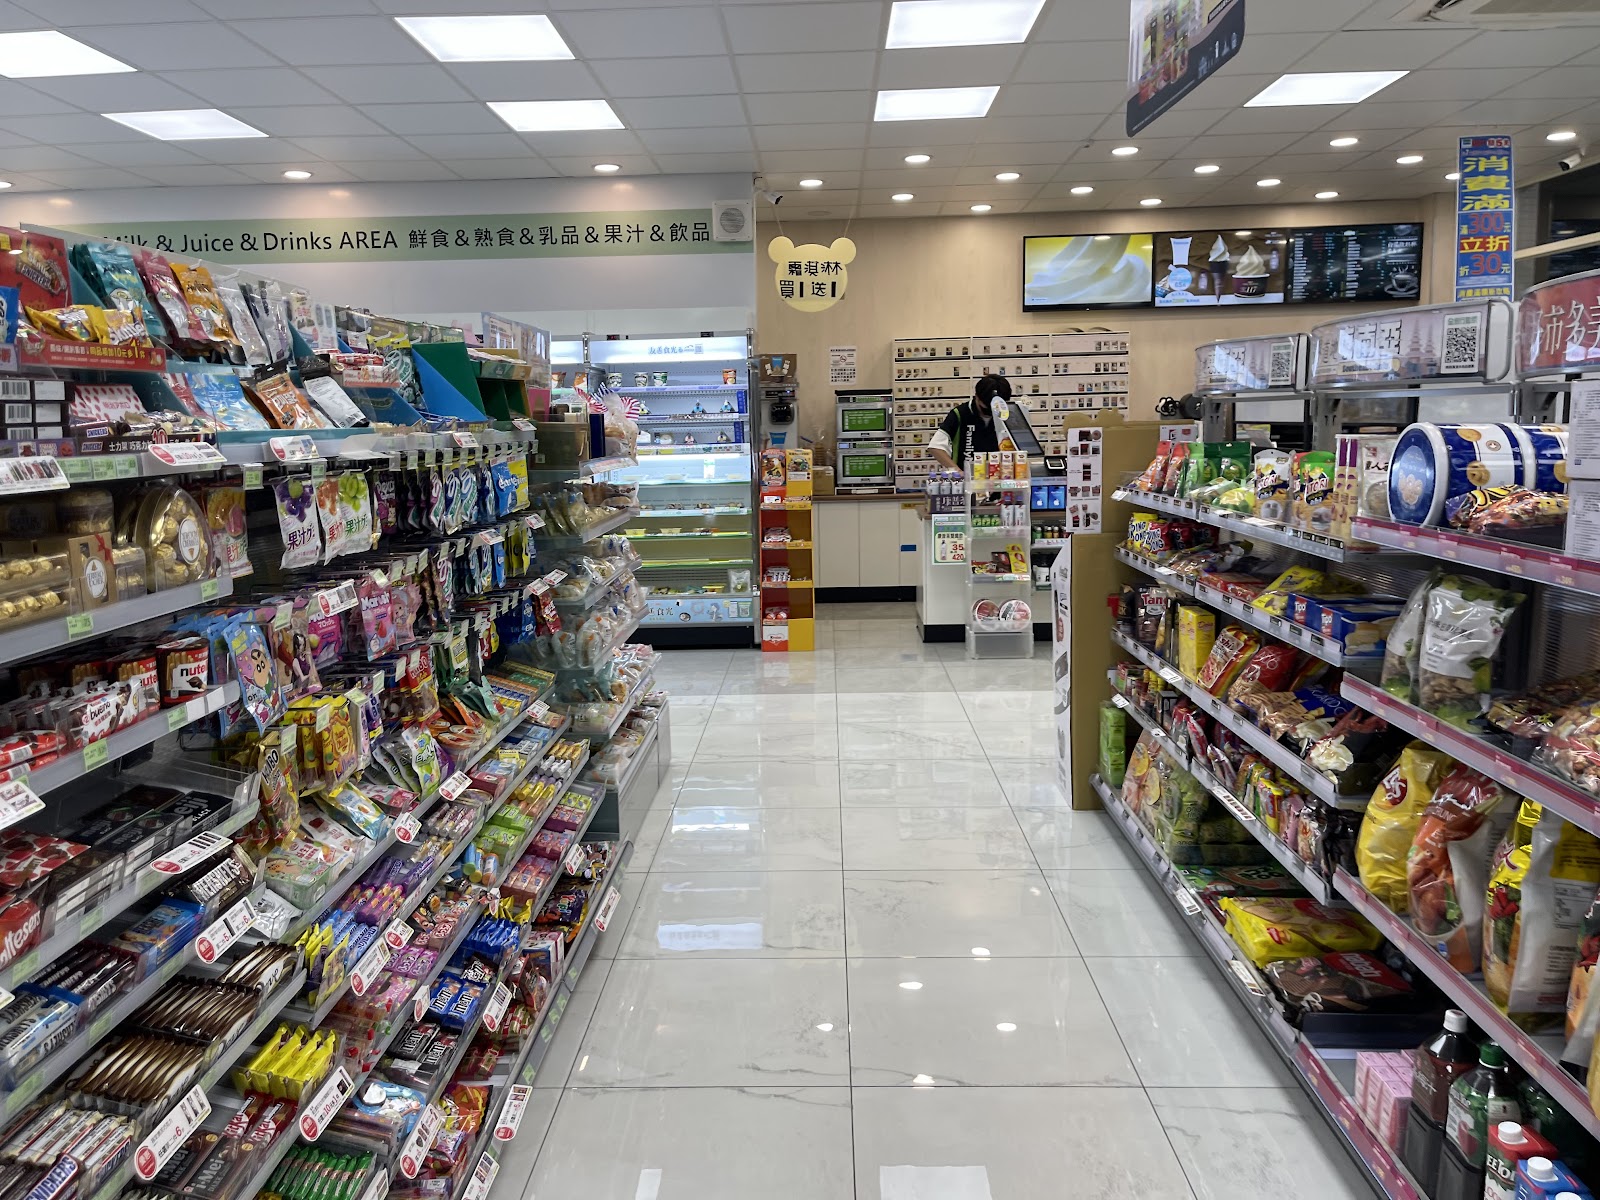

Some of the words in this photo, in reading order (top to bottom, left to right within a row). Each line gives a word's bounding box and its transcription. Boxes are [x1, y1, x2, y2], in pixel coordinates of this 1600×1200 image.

[181, 233, 234, 253] Juice
[240, 232, 258, 251] &
[264, 231, 332, 251] Drinks
[339, 230, 398, 249] AREA
[408, 221, 711, 249] 鮮食&熟食&乳品&果汁&飲品
